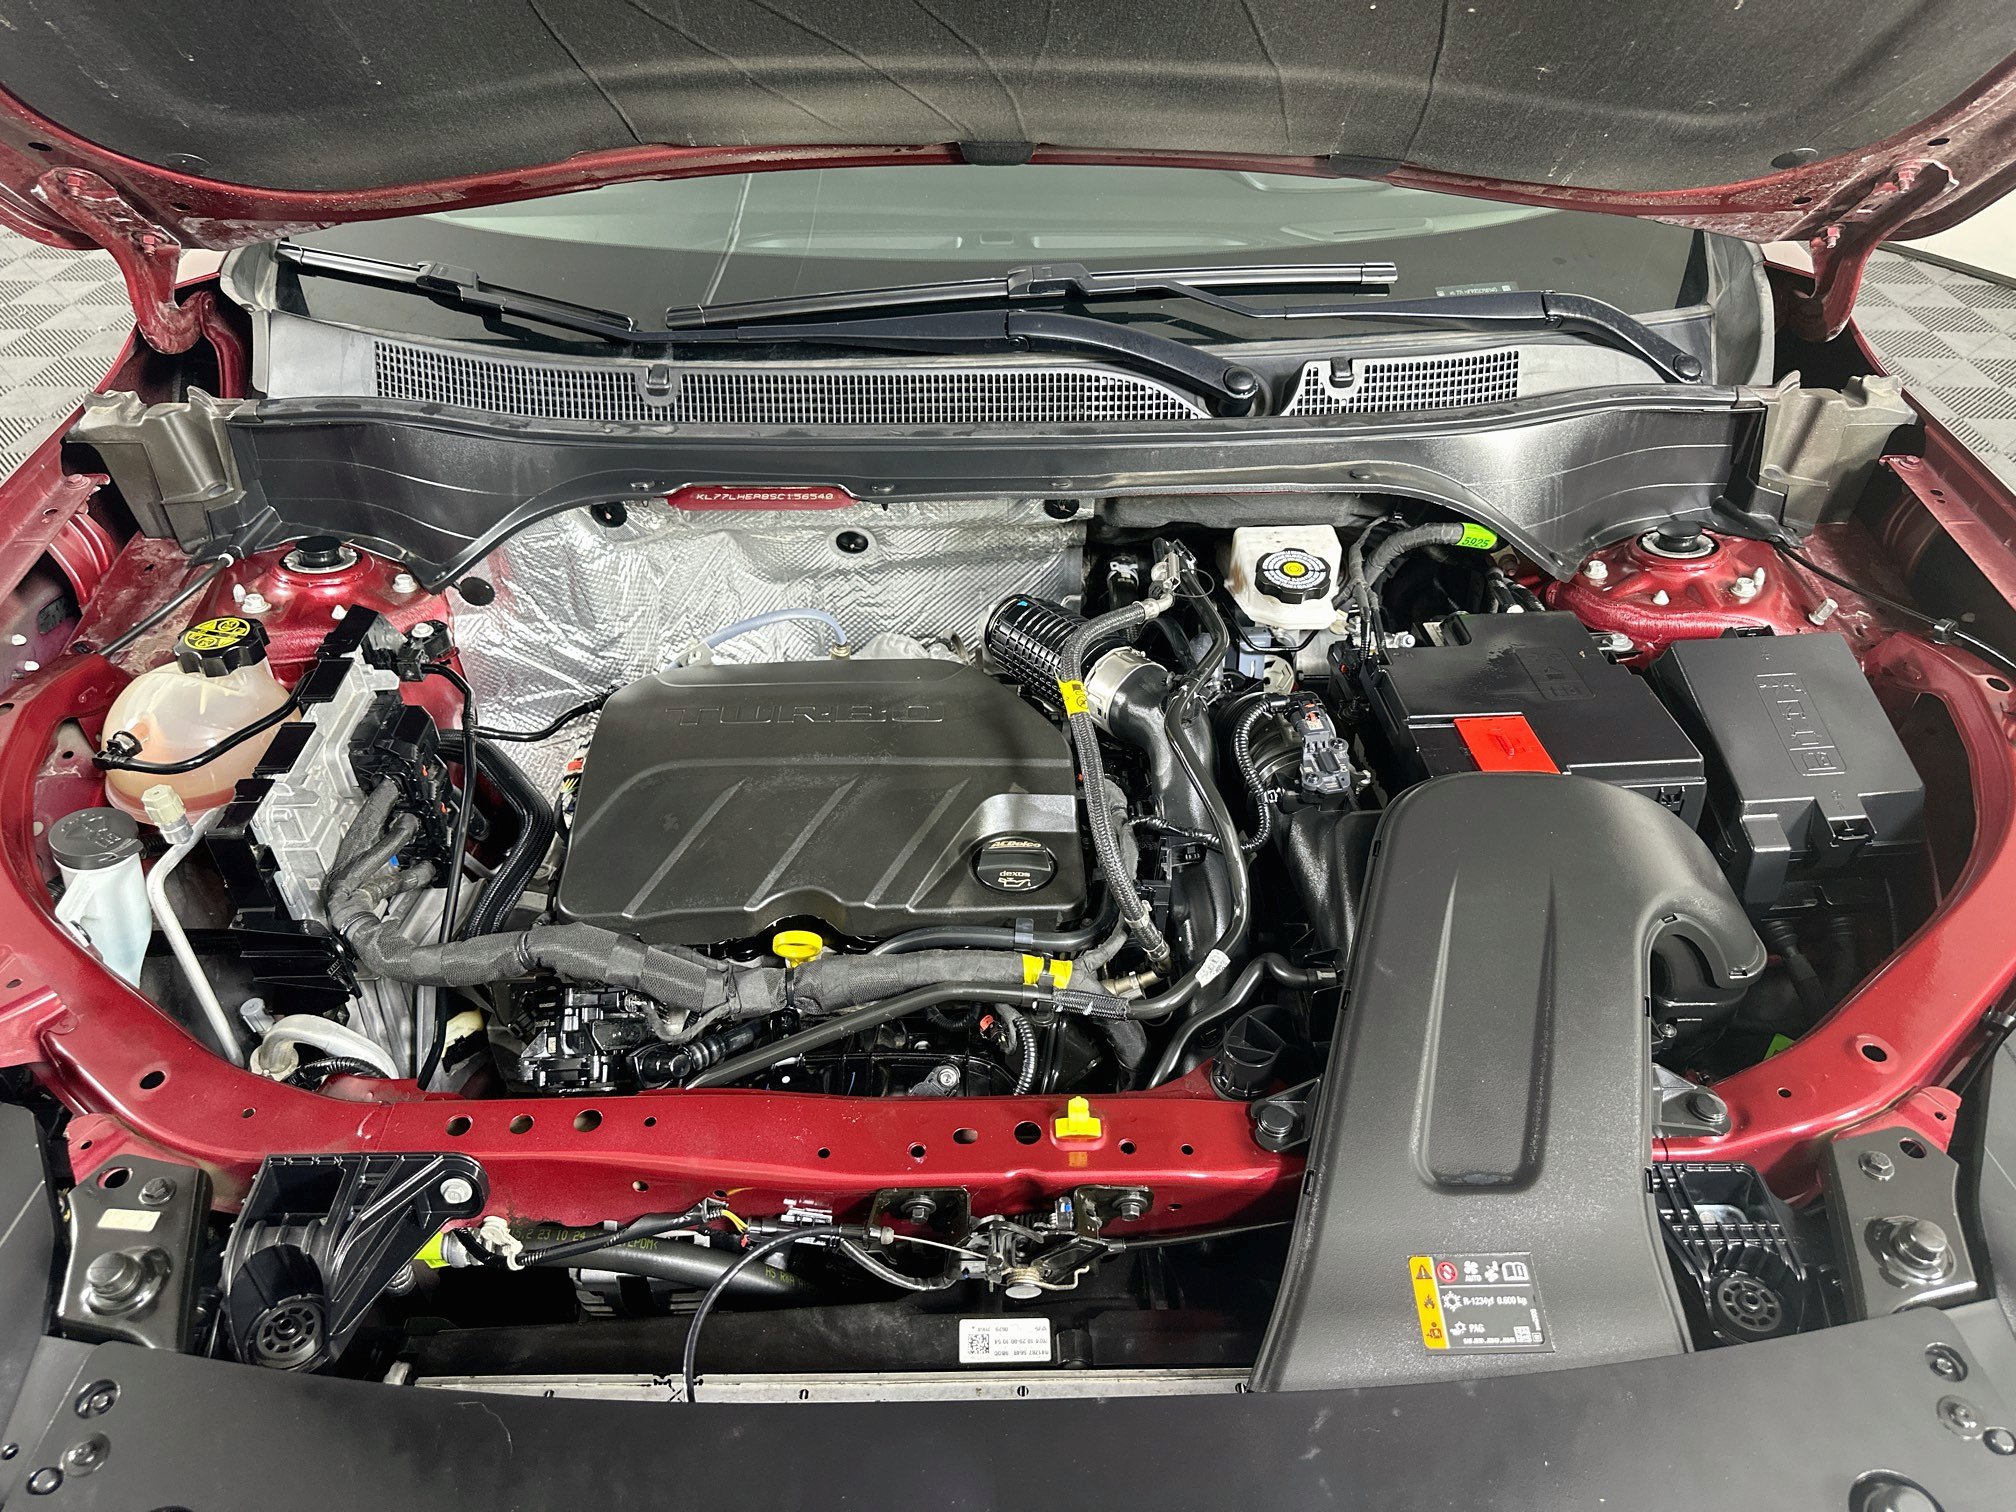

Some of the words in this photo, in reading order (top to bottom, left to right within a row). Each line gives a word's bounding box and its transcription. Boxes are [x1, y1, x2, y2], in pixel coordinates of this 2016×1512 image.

[1462, 536, 1490, 548] 5925
[665, 704, 944, 726] TURBO
[988, 840, 1042, 850] ACDelco
[1468, 1323, 1485, 1333] PAG
